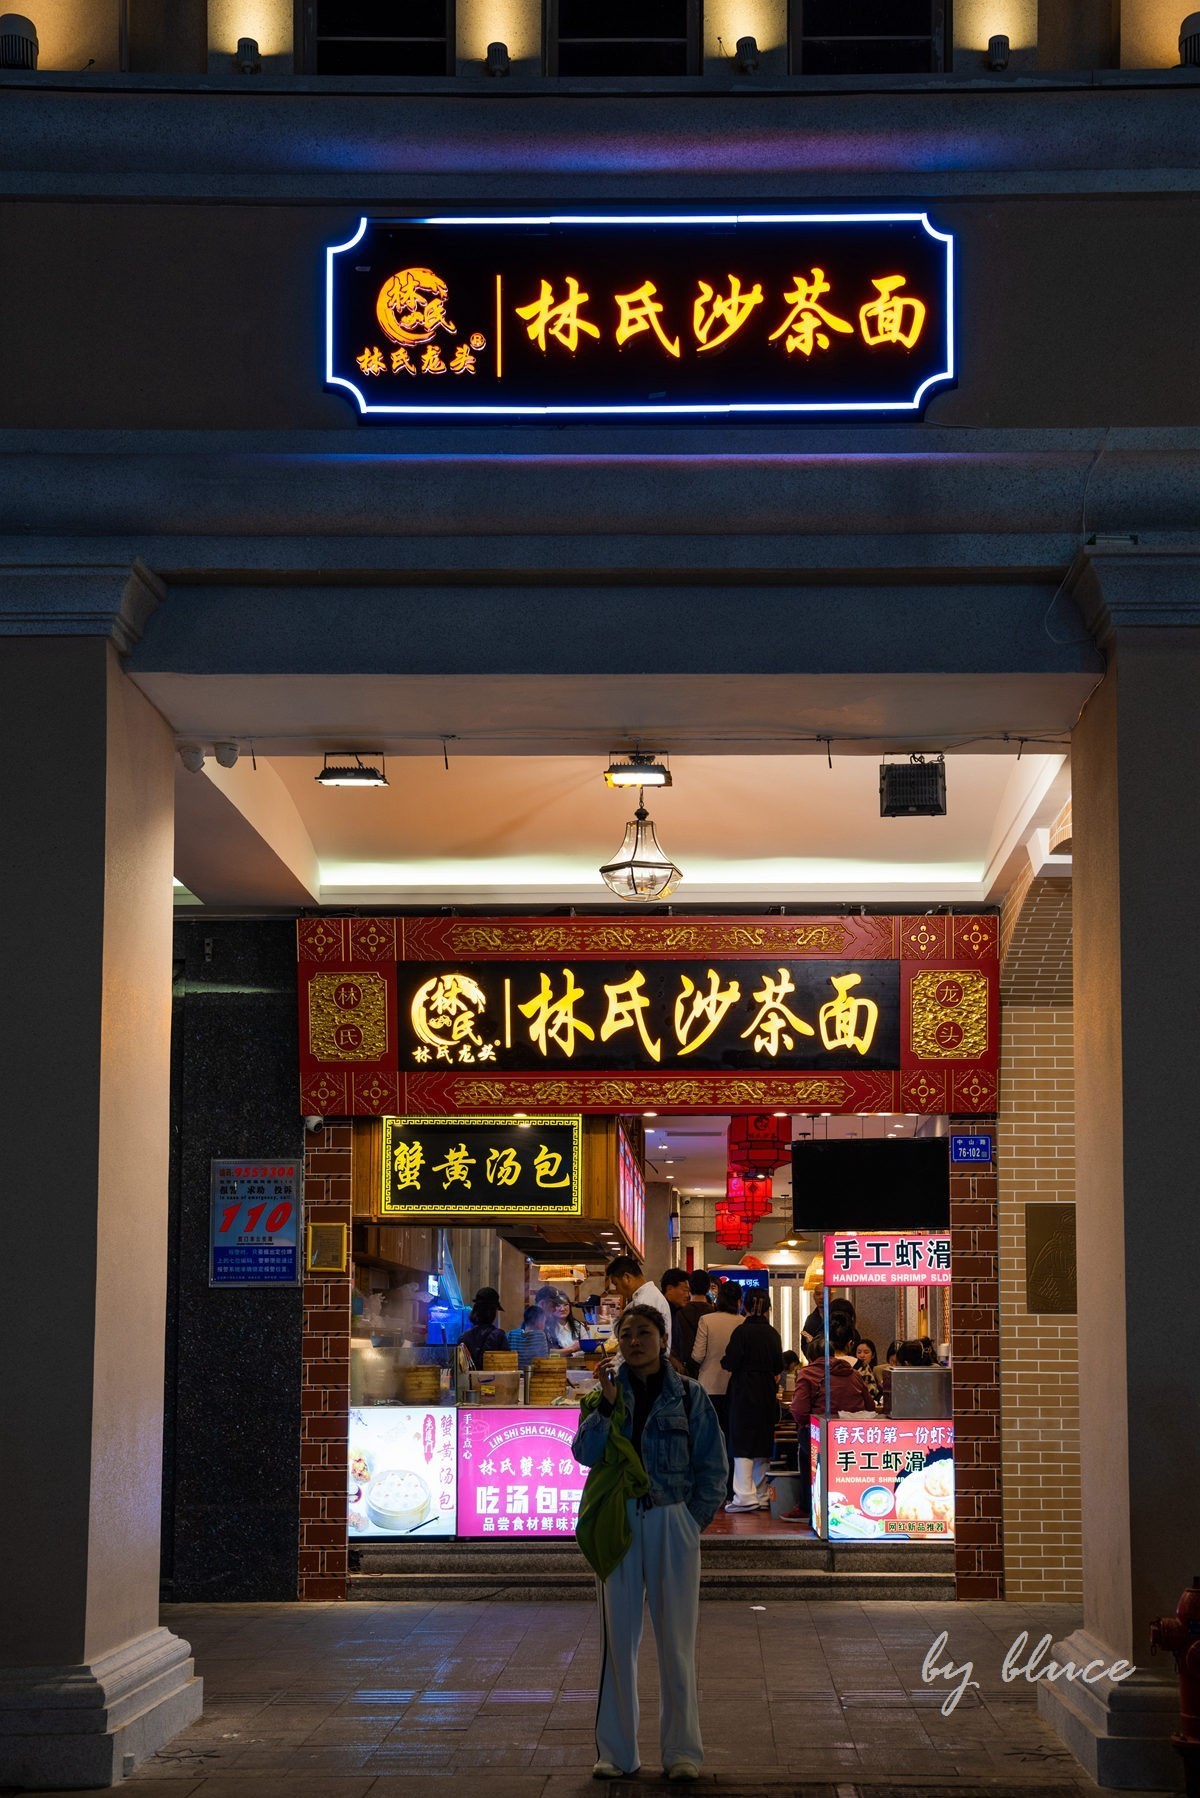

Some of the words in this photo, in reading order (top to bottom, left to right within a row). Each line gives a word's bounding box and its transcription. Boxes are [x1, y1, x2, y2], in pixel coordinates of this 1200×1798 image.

[515, 268, 927, 358] 林氏沙茶面
[356, 344, 477, 377] 林氏龙头
[337, 987, 359, 1047] 林氏
[517, 968, 879, 1062] 林氏沙茶面
[939, 985, 960, 1045] 龙头
[412, 1044, 497, 1064] 林氏龙头
[956, 1138, 986, 1146] 中山路
[393, 1140, 571, 1191] 蟹黄汤包
[218, 1201, 293, 1233] 110
[833, 1239, 950, 1270] 手工虾滑
[833, 1273, 887, 1282] HANDMADE
[890, 1273, 927, 1282] SHRIMP
[462, 1413, 473, 1460] 手工点心
[488, 1434, 504, 1449] LIN
[503, 1428, 519, 1440] SHI
[520, 1425, 537, 1436] SHA
[538, 1425, 557, 1437] CHA
[556, 1431, 574, 1445] MIA
[437, 1414, 455, 1511] 蟹黄汤包
[836, 1450, 926, 1472] 手工虾滑
[476, 1485, 558, 1515] 吃汤包
